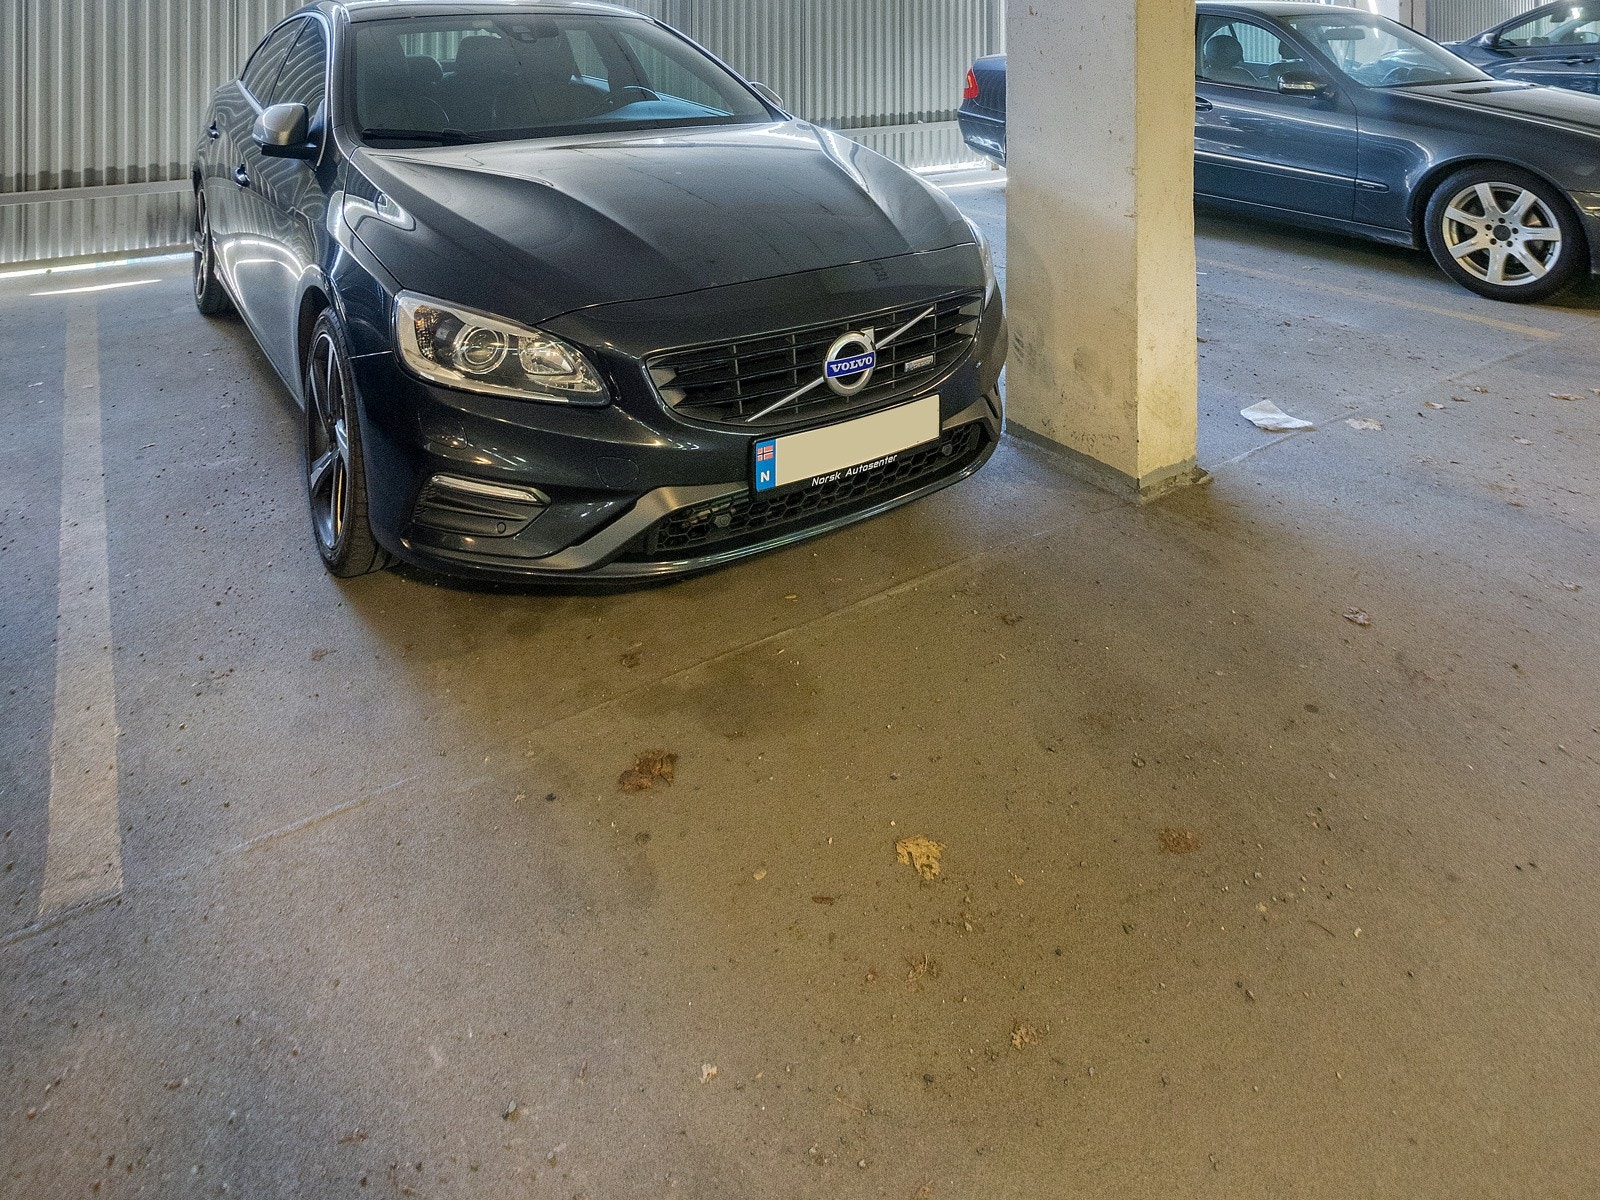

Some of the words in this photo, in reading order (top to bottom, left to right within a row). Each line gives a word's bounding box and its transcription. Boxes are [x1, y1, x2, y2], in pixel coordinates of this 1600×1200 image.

[830, 356, 873, 373] VOLVO
[760, 470, 770, 483] N
[811, 471, 841, 487] Norsk
[845, 454, 898, 478] Autosenter
